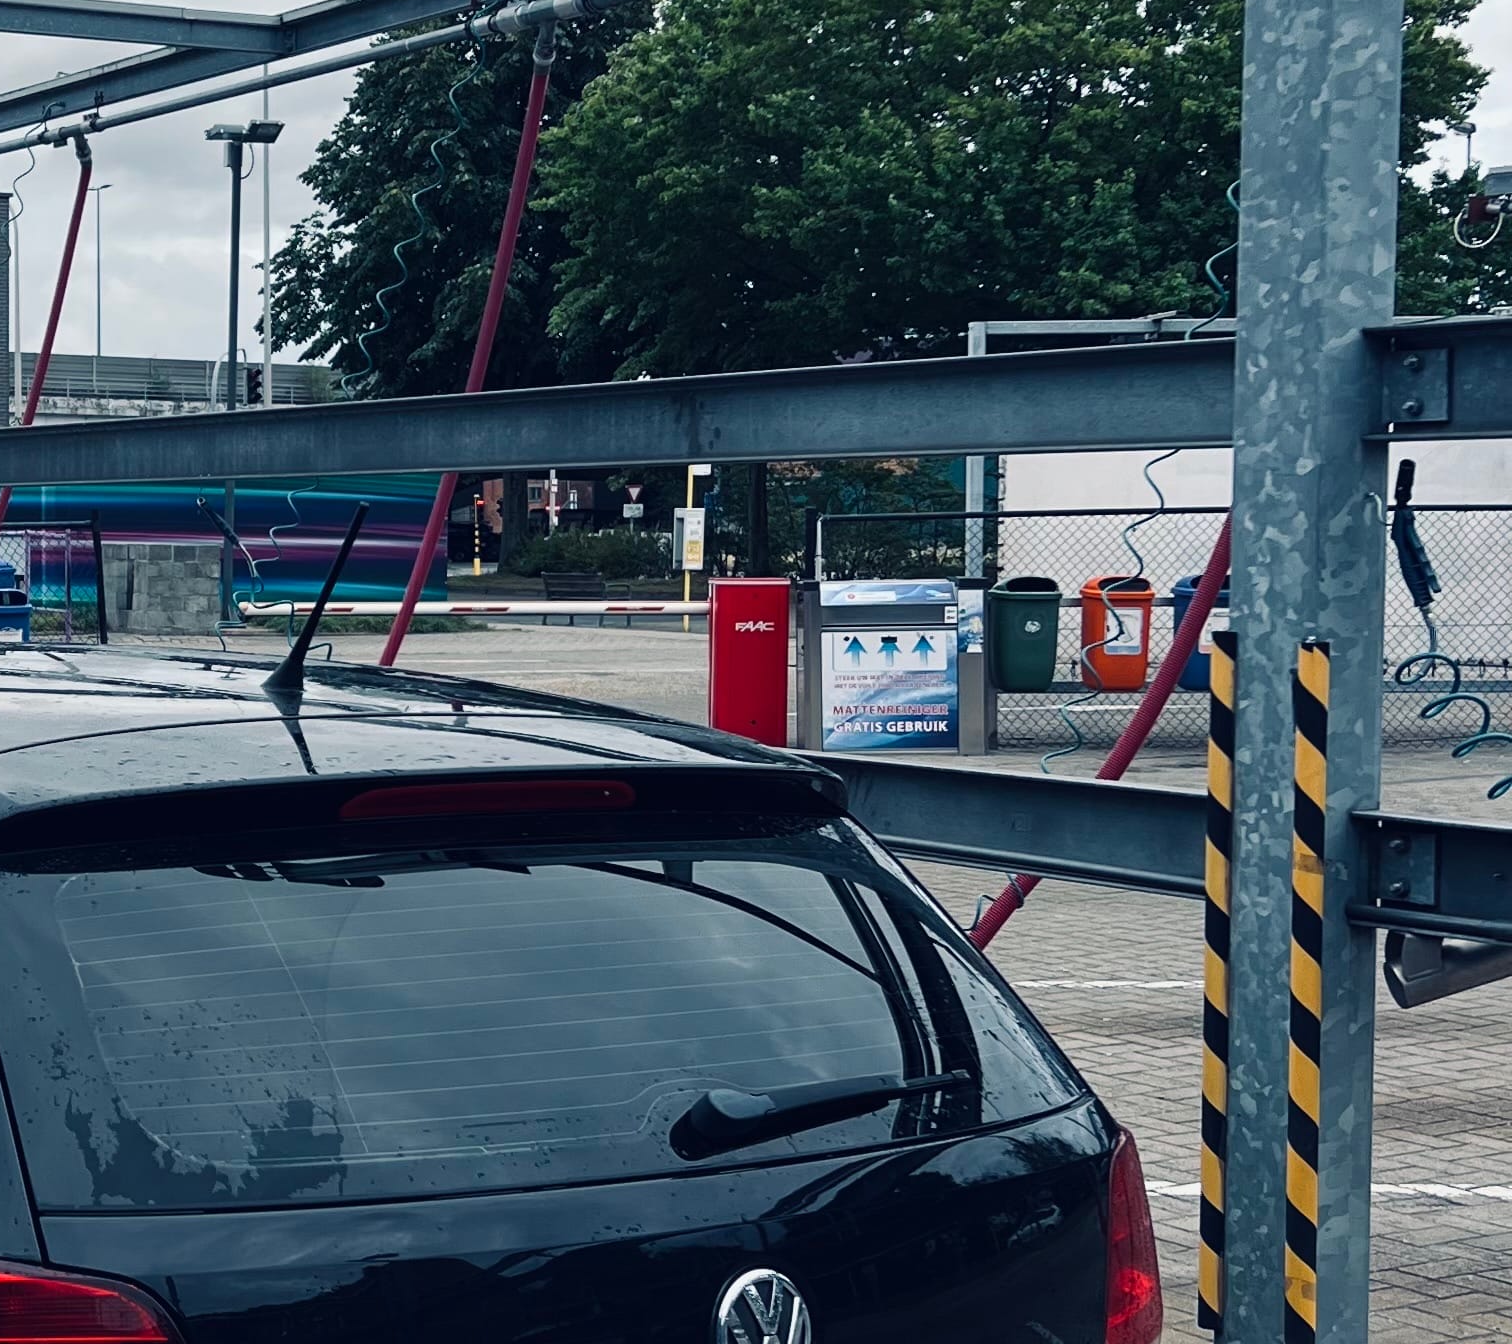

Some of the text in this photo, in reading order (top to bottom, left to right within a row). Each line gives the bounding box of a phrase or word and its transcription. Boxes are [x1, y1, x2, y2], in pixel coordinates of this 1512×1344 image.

[735, 620, 775, 632] FAAC
[833, 704, 948, 715] MATTENREINIGER
[834, 720, 949, 733] GRATIS GEBRUIK
